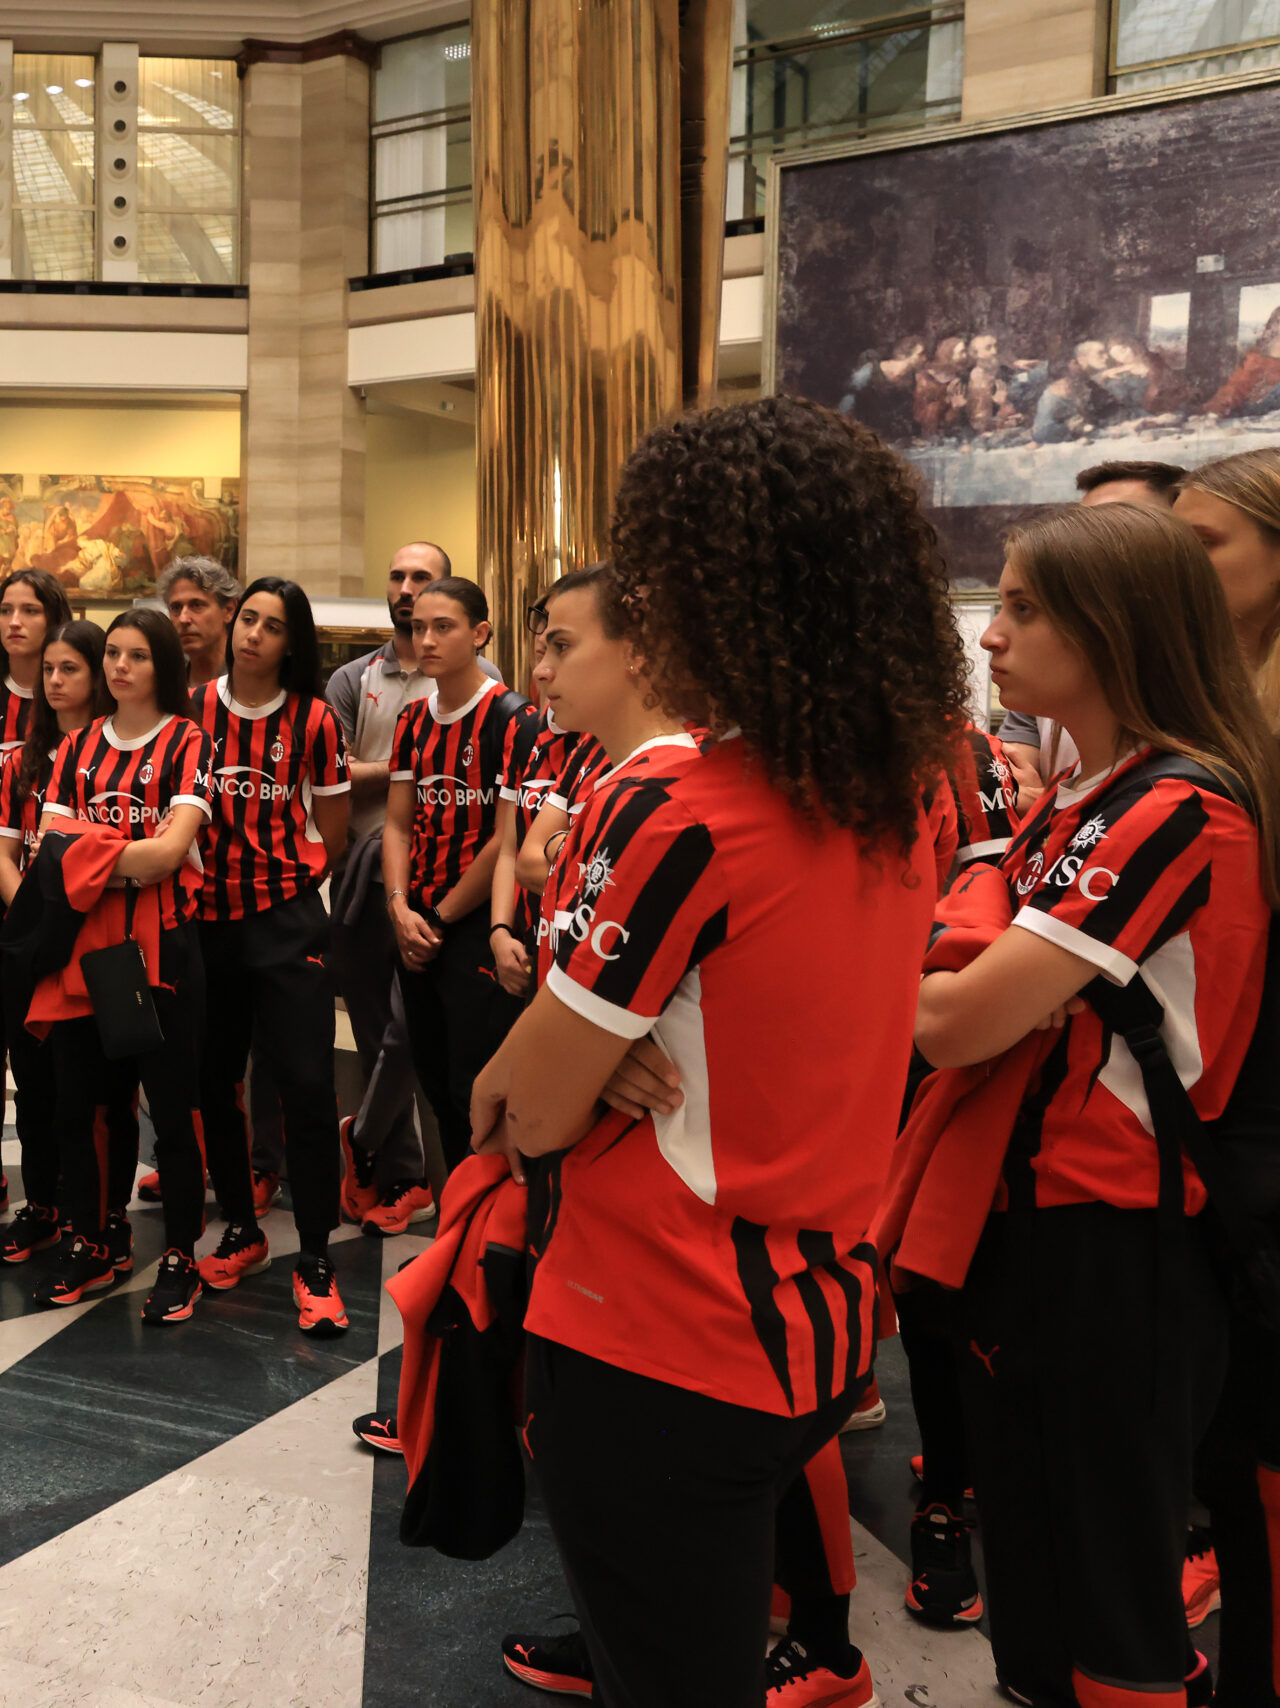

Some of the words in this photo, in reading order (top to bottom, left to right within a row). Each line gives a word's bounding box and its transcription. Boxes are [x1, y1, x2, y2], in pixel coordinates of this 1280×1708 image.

[213, 777, 256, 798] NCO
[259, 783, 297, 801] BPM
[417, 787, 452, 806] NCO
[455, 787, 494, 806] BPM
[76, 806, 124, 824] ANCO
[128, 806, 169, 824] BPM
[569, 903, 630, 961] SC
